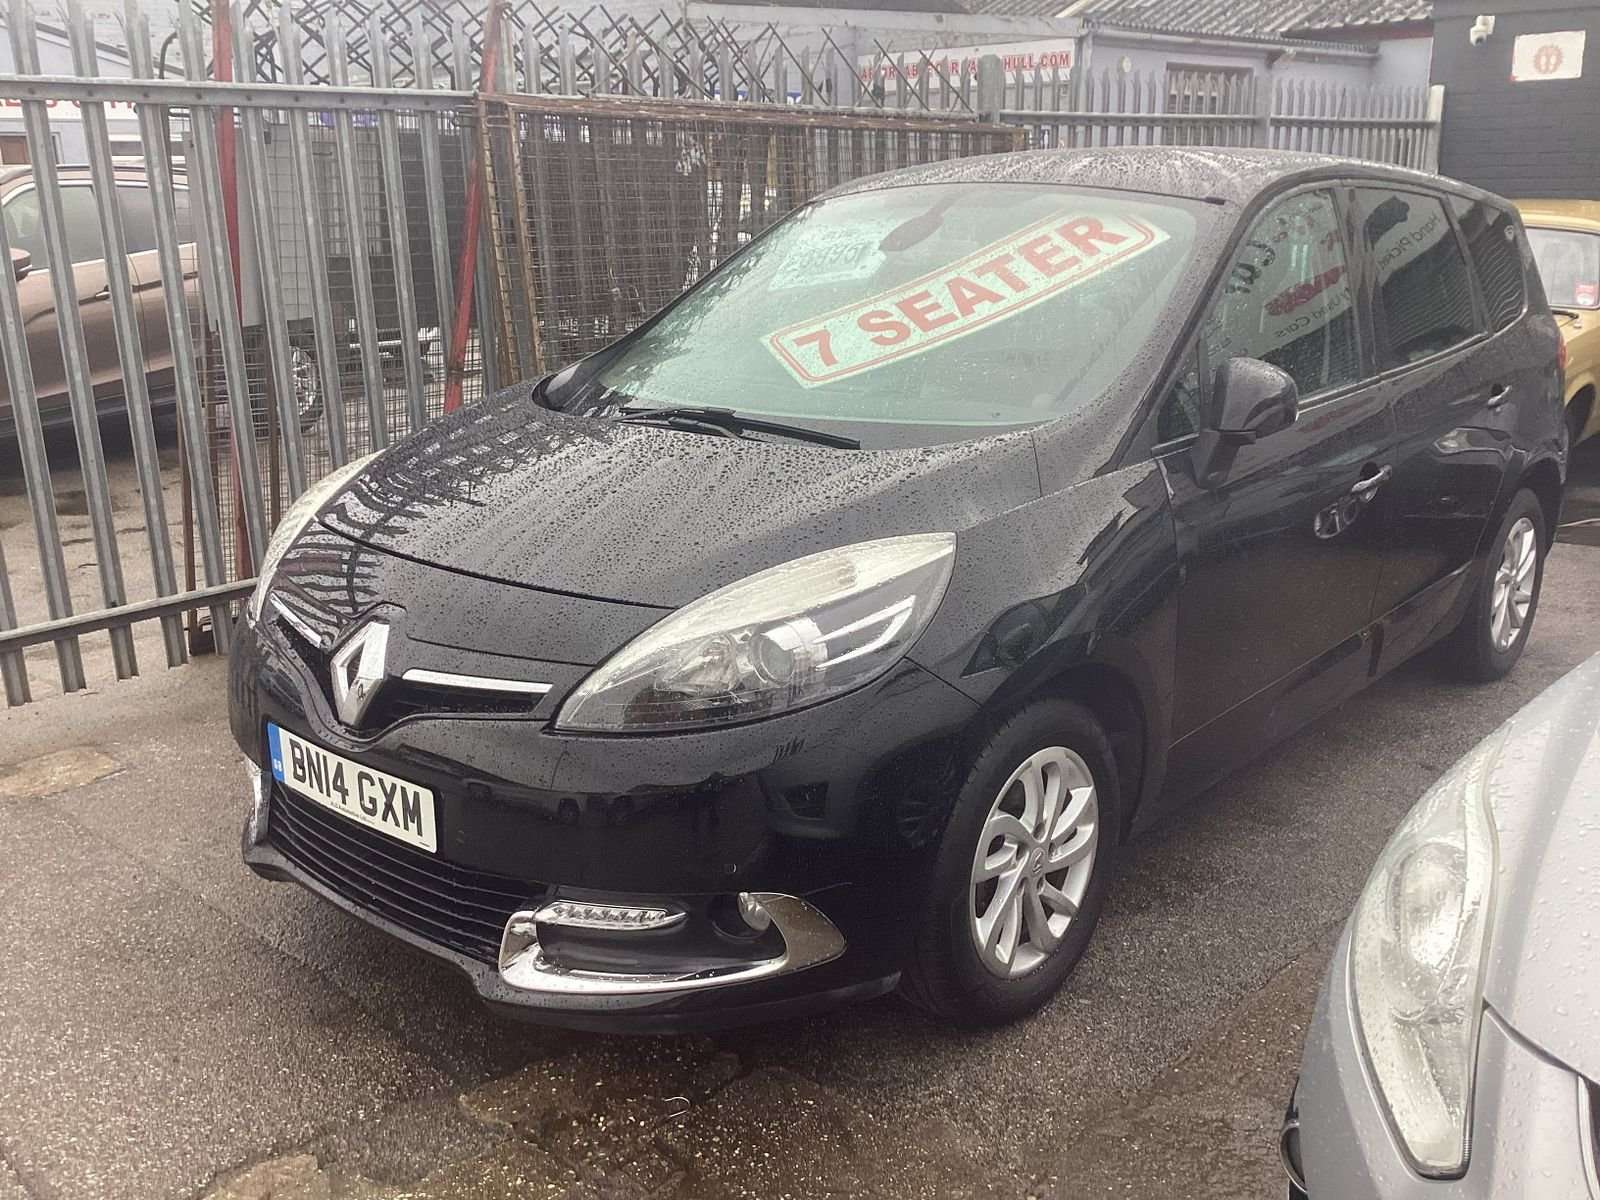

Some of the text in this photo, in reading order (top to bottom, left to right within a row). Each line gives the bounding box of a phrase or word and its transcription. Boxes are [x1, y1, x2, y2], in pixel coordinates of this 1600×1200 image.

[795, 329, 839, 368] 7
[857, 216, 1129, 347] SEATER
[288, 737, 423, 838] BN14 GXM
